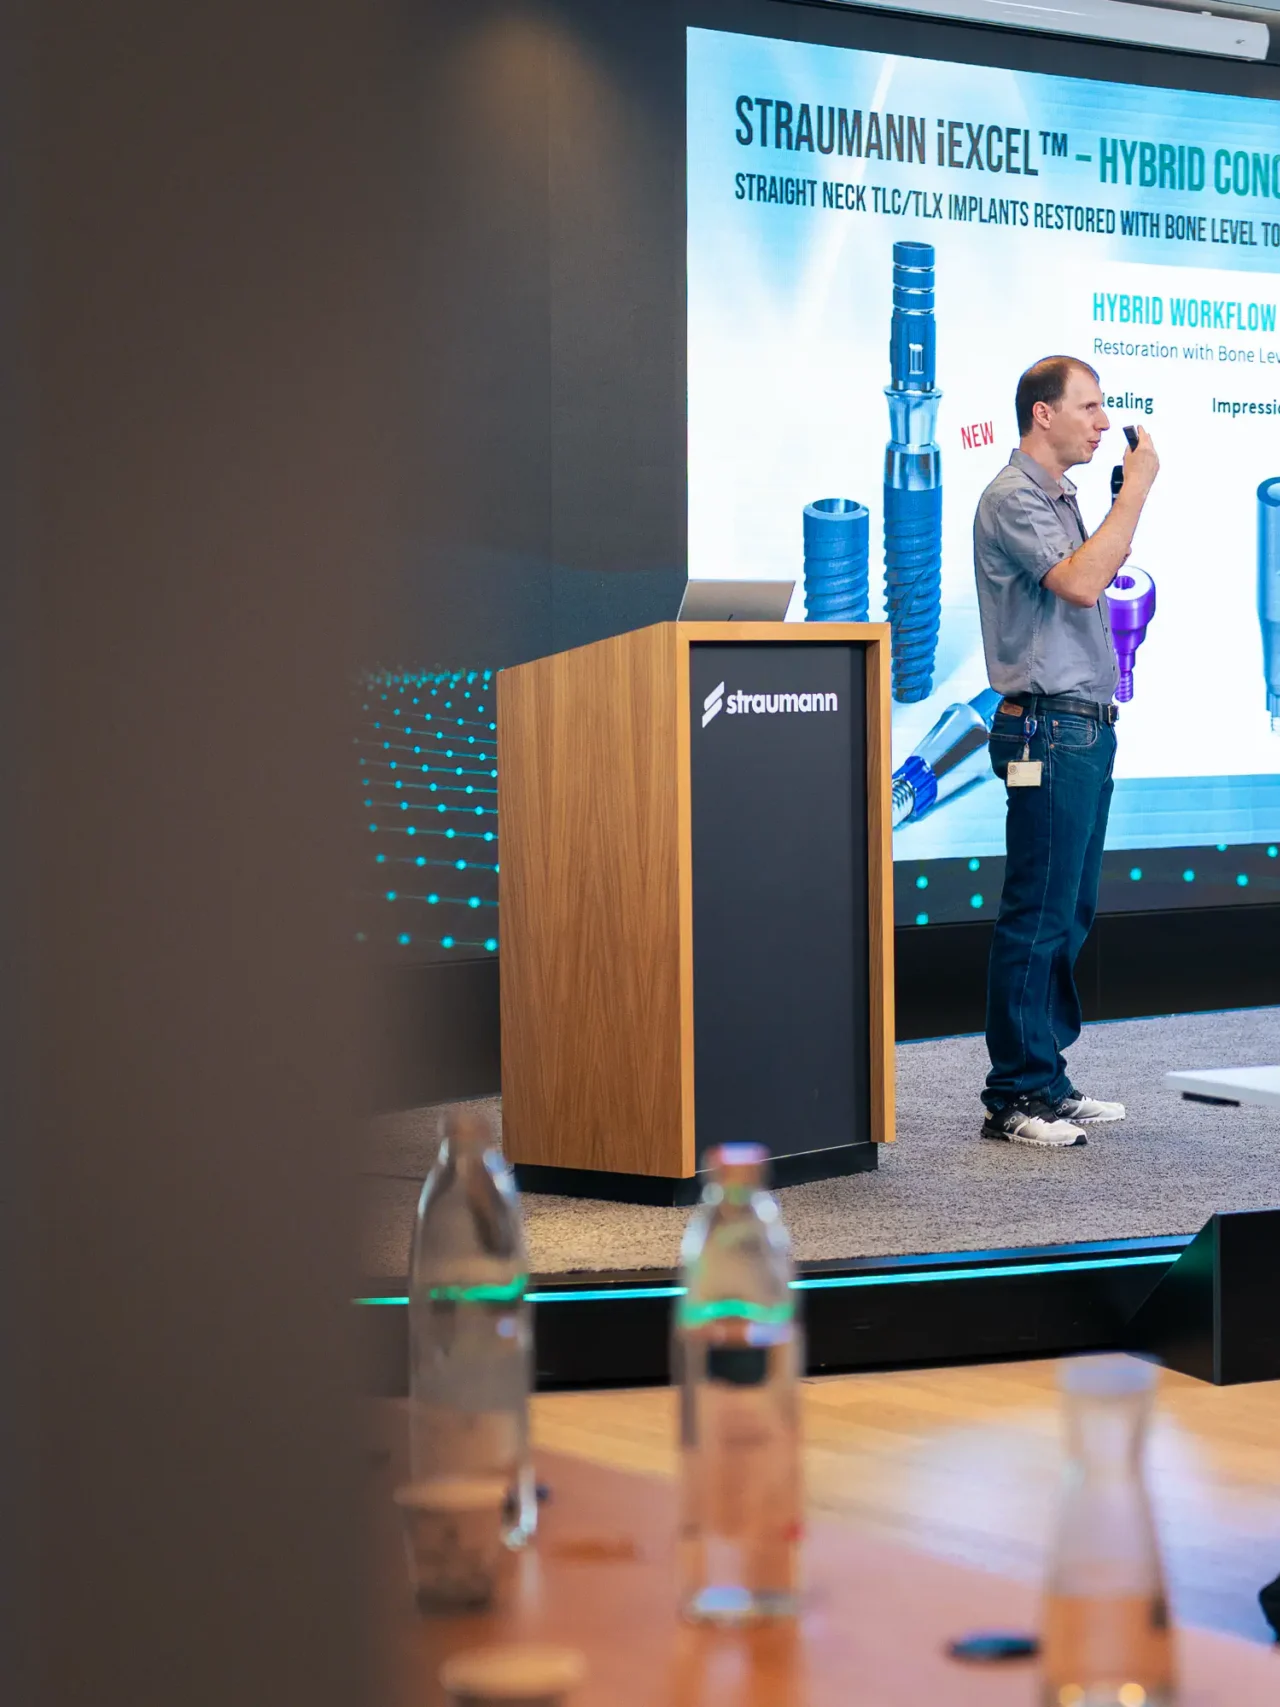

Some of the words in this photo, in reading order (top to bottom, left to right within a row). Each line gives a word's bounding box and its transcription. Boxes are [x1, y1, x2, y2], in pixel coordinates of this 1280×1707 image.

[735, 95, 926, 165] STRAUMANN
[1100, 137, 1206, 192] HYBRID
[735, 173, 818, 207] STRAIGHT
[823, 181, 867, 212] NECK
[871, 186, 943, 219] TLC/TLX
[948, 194, 1030, 227] IMPLANTS
[1034, 203, 1116, 235] RESTORED
[1120, 209, 1161, 239] WITH
[1164, 213, 1207, 242] BONE
[1211, 218, 1258, 247] LEVEL
[1093, 292, 1164, 326] HYBRID
[1170, 298, 1277, 332] WORKFLOW
[1093, 338, 1178, 360] Restoration
[1183, 343, 1214, 361] with
[1218, 345, 1255, 364] Bone
[961, 420, 994, 450] NEW
[726, 690, 838, 714] straumann
